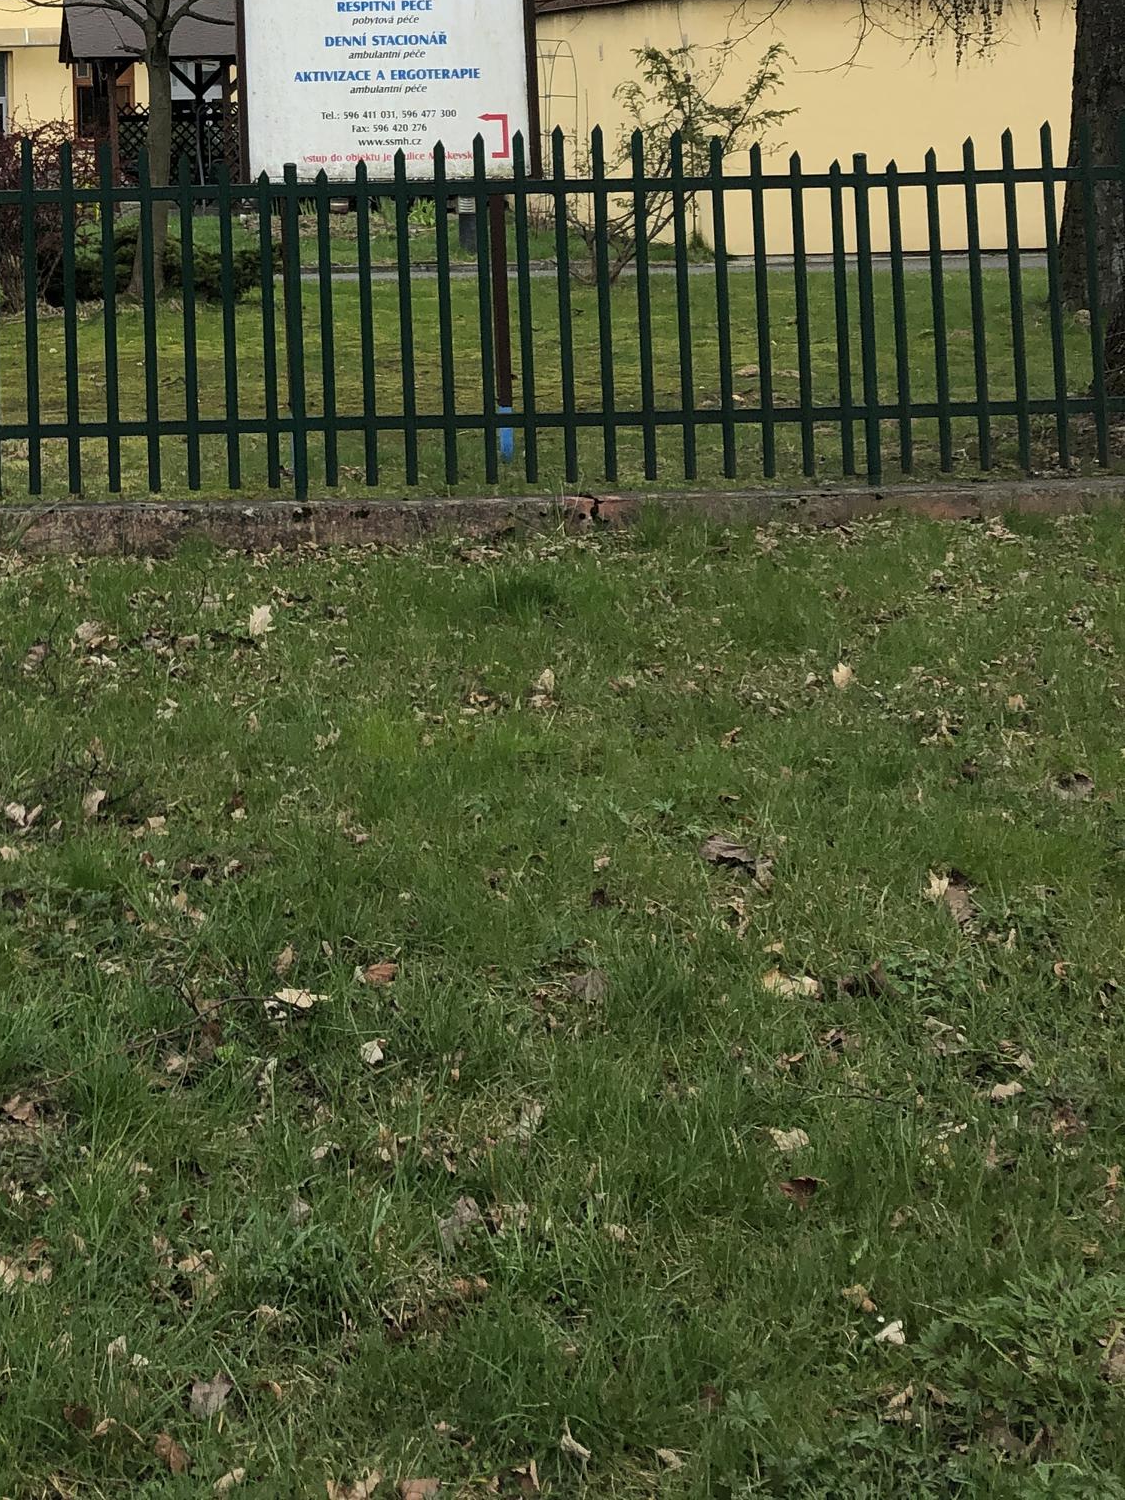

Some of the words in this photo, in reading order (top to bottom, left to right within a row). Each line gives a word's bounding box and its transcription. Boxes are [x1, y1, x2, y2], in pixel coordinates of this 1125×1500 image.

[351, 15, 394, 26] pobytová
[396, 14, 420, 25] péče
[324, 32, 367, 48] DENNÍ
[371, 31, 448, 47] STACIONÁŘ
[348, 49, 401, 60] ambulantní
[403, 48, 427, 60] péče
[293, 69, 372, 83] AKTIVIZACE
[376, 69, 386, 81] A
[390, 67, 482, 81] ERGOTERAPIE
[349, 84, 403, 95] ambulantní
[404, 83, 428, 94] péče
[320, 111, 340, 120] Tel.:
[343, 111, 360, 120] 596
[362, 110, 378, 119] 411
[380, 110, 399, 120] 031,
[401, 110, 418, 119] 596
[420, 109, 437, 118] 477
[440, 109, 457, 118] 300
[351, 125, 370, 133] Fax:
[372, 124, 389, 133] 596
[391, 124, 409, 132] 420
[411, 123, 428, 132] 276
[358, 137, 422, 147] www.ssmh.cz
[303, 154, 328, 164] vstup
[330, 153, 343, 162] do
[383, 152, 392, 163] je
